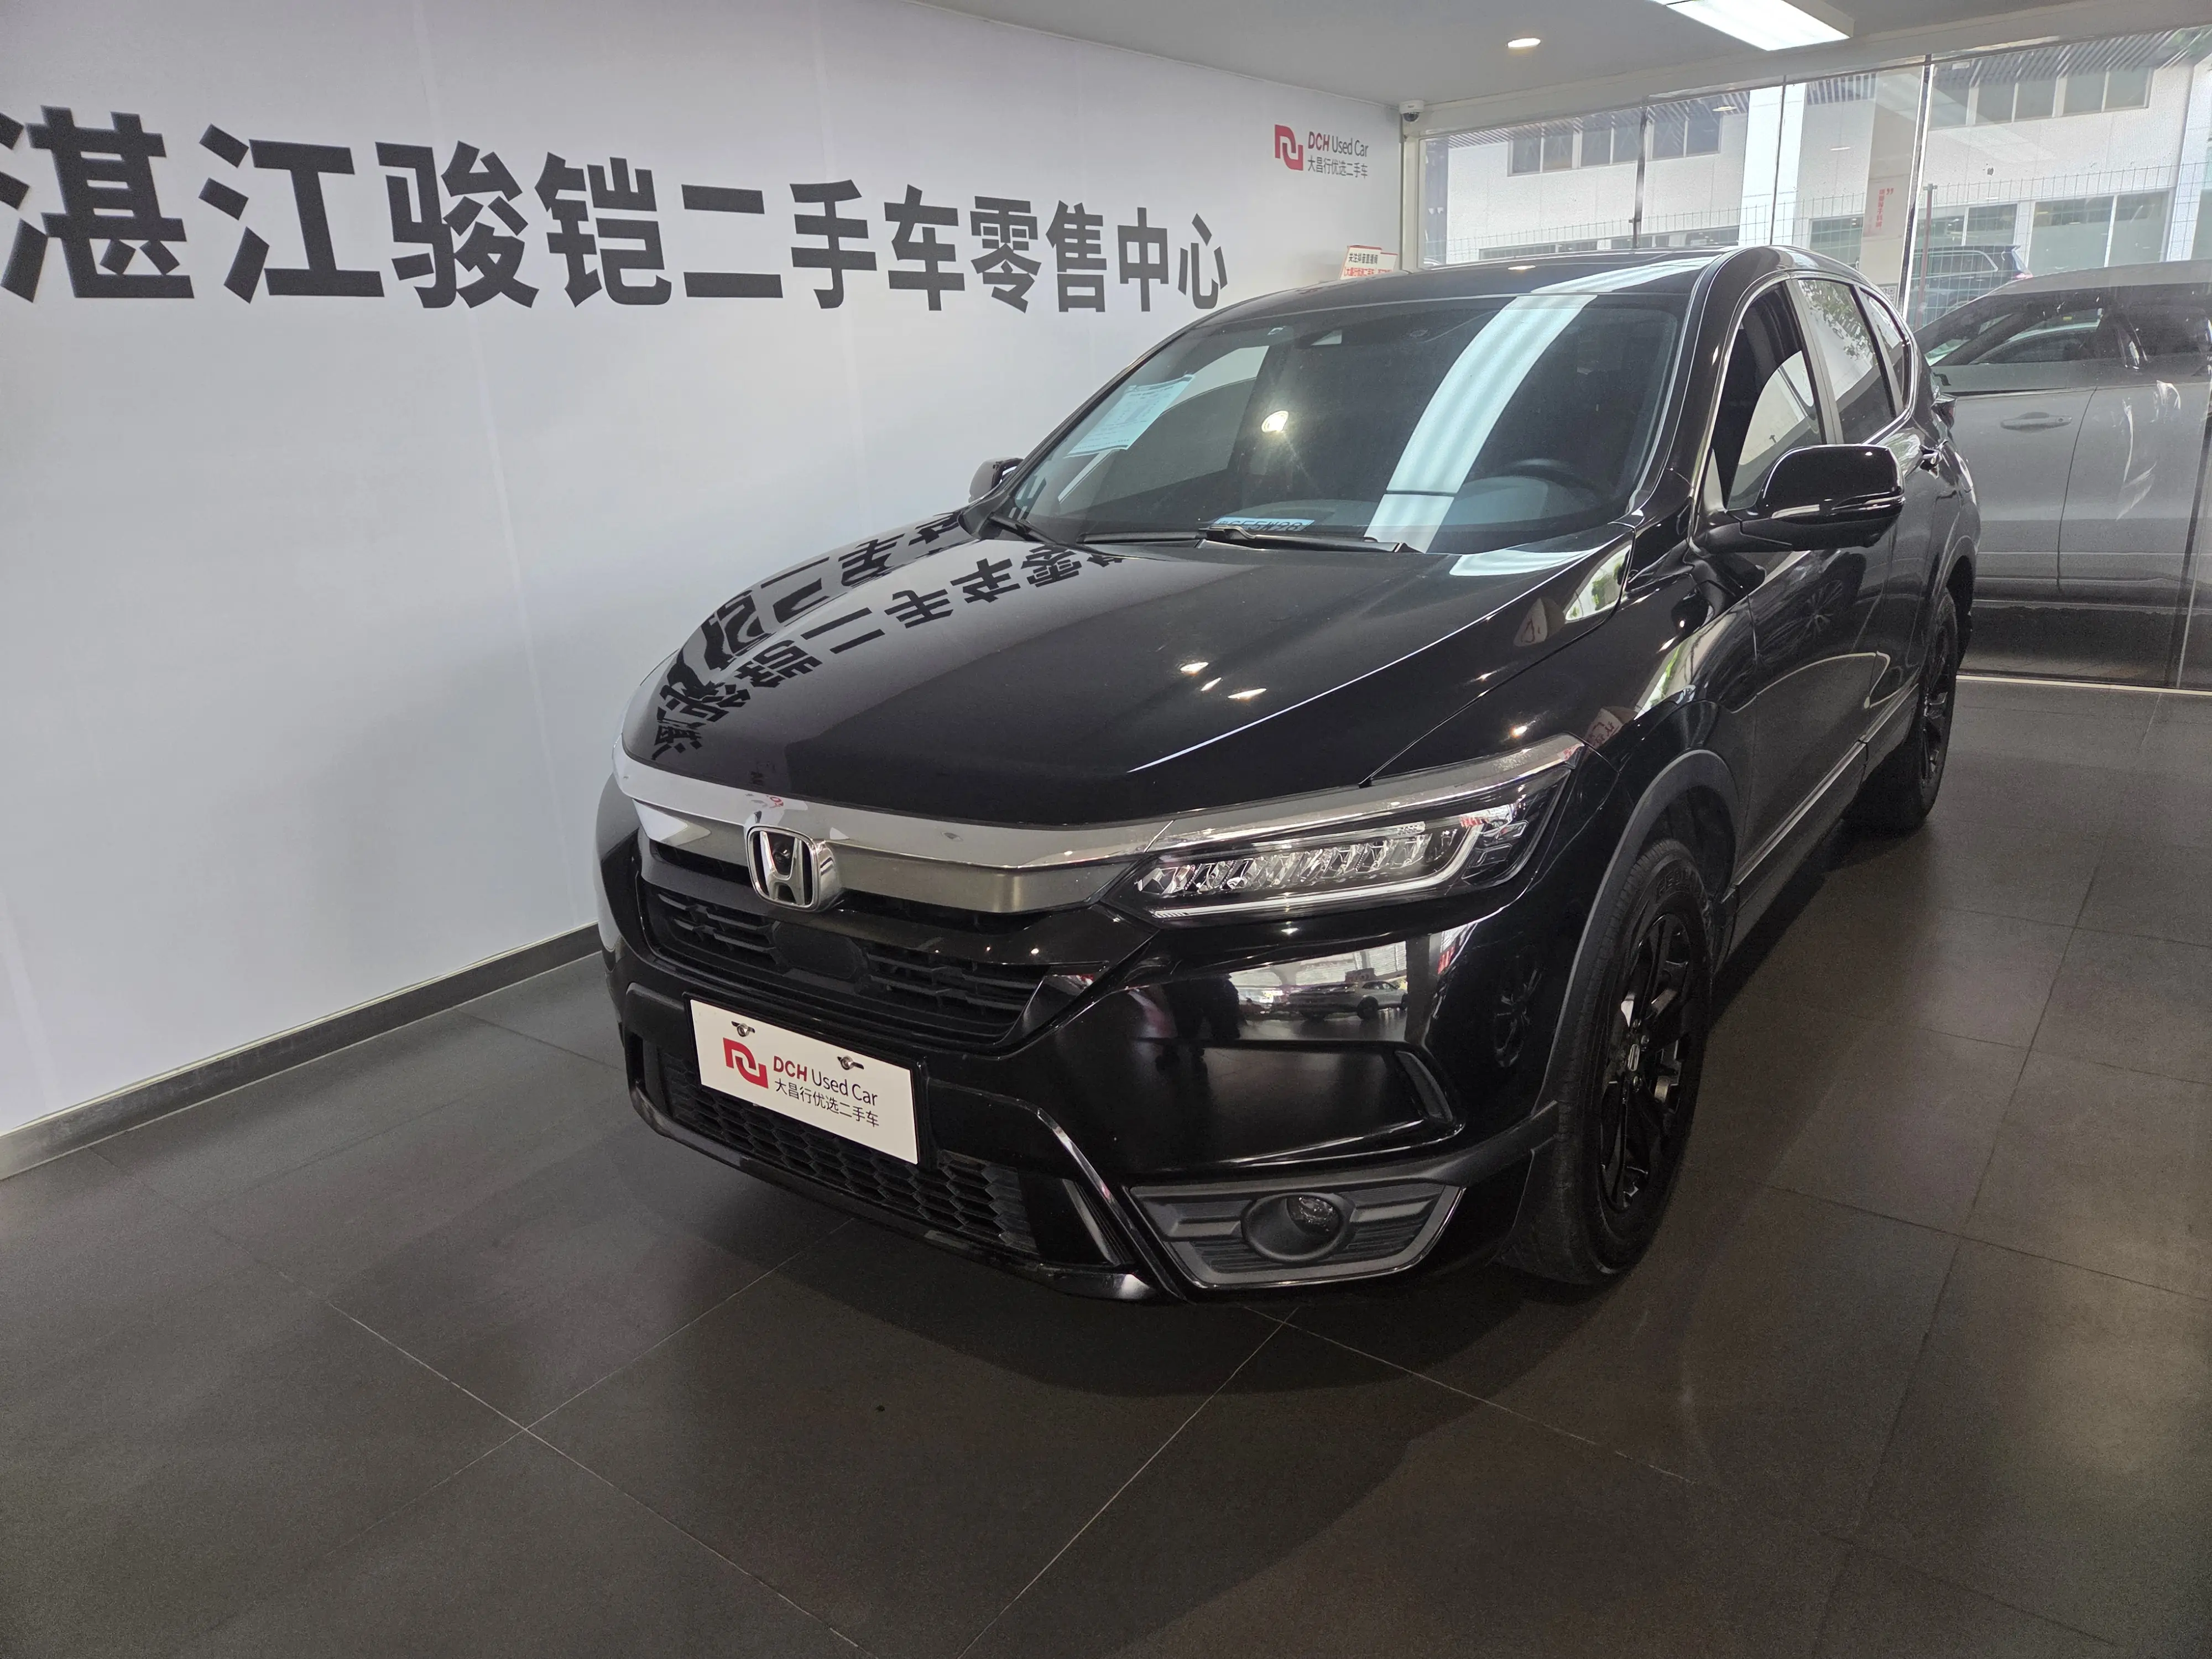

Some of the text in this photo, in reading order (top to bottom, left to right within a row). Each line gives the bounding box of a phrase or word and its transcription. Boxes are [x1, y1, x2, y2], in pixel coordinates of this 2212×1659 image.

[1307, 155, 1368, 179] 大昌行优选二手车
[1308, 131, 1369, 157] DCH Used Car
[0, 105, 1228, 314] 湛江骏铠二手车零售中心
[773, 1055, 878, 1106] DCH Used Car
[775, 1078, 879, 1128] 大昌行优选二手车
